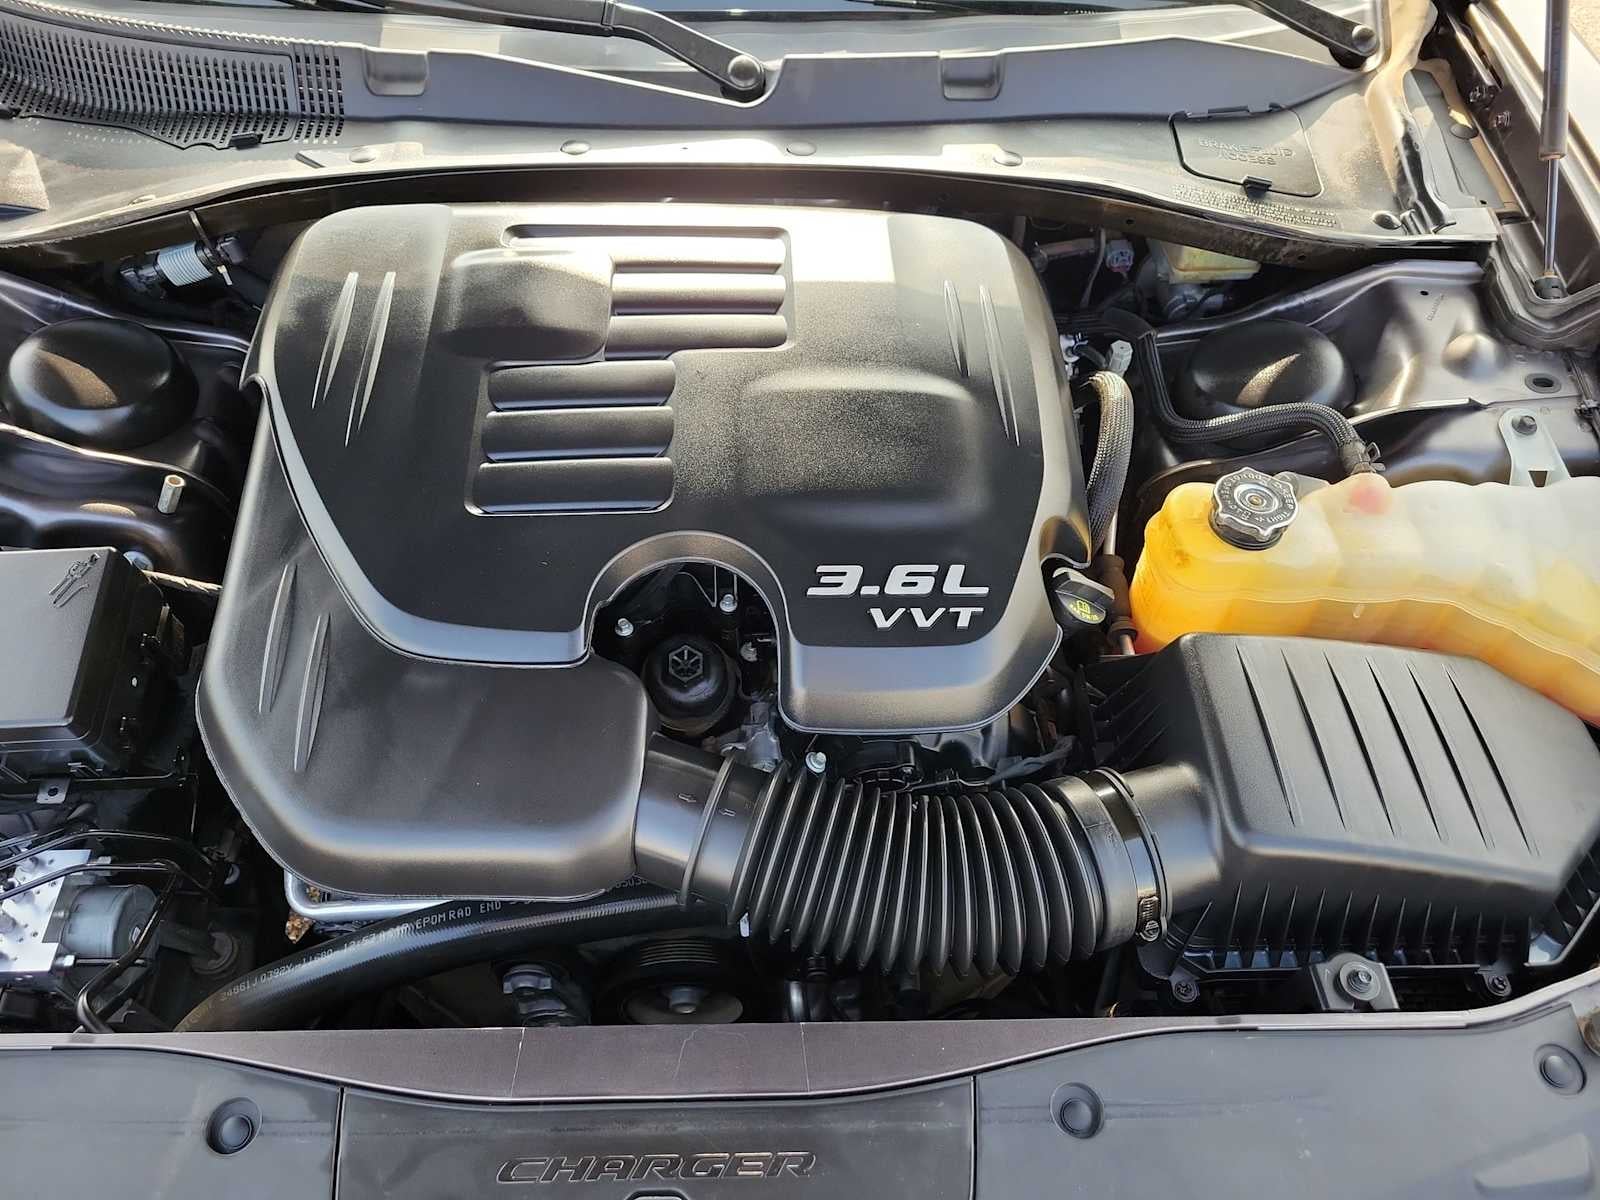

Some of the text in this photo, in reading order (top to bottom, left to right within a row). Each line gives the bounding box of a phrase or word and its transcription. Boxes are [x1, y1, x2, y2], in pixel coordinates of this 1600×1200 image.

[806, 564, 990, 597] 3.6L
[867, 607, 985, 631] VVT
[479, 900, 502, 914] END
[495, 1151, 817, 1184] CHARGER
